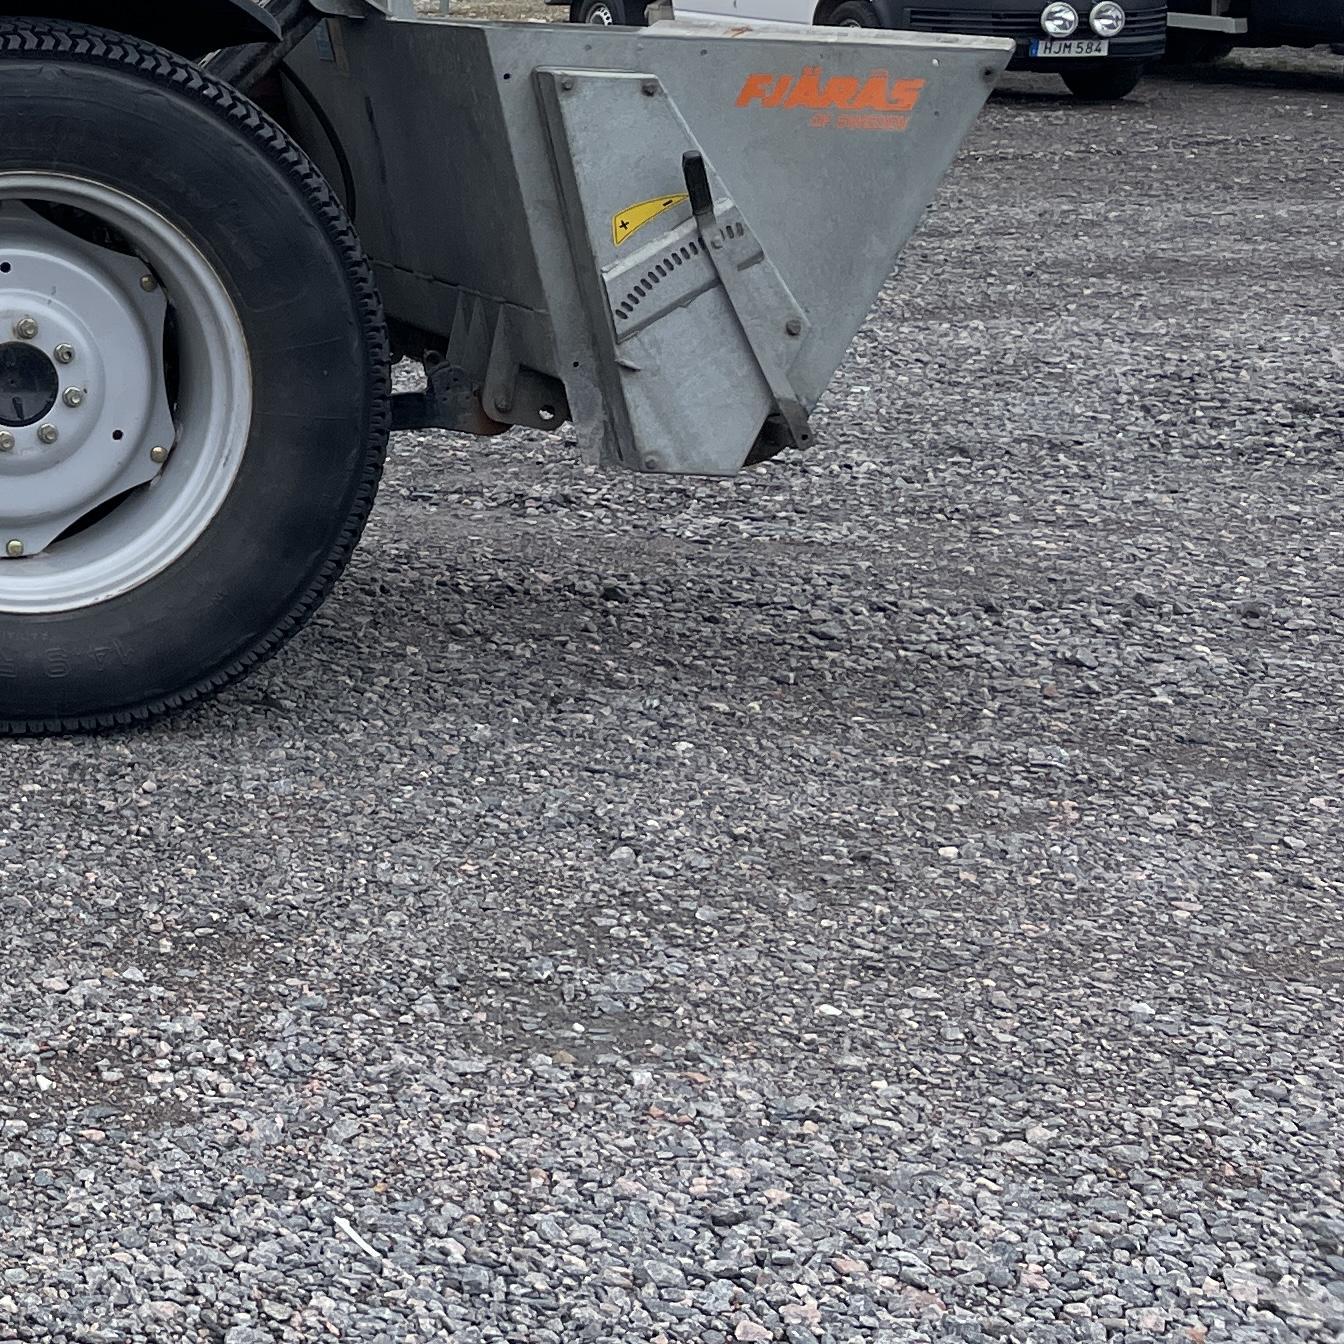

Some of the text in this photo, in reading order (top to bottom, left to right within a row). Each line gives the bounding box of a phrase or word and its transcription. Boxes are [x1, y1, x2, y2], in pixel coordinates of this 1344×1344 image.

[1043, 41, 1101, 55] HJM 584
[735, 65, 927, 111] FJÄRÅS
